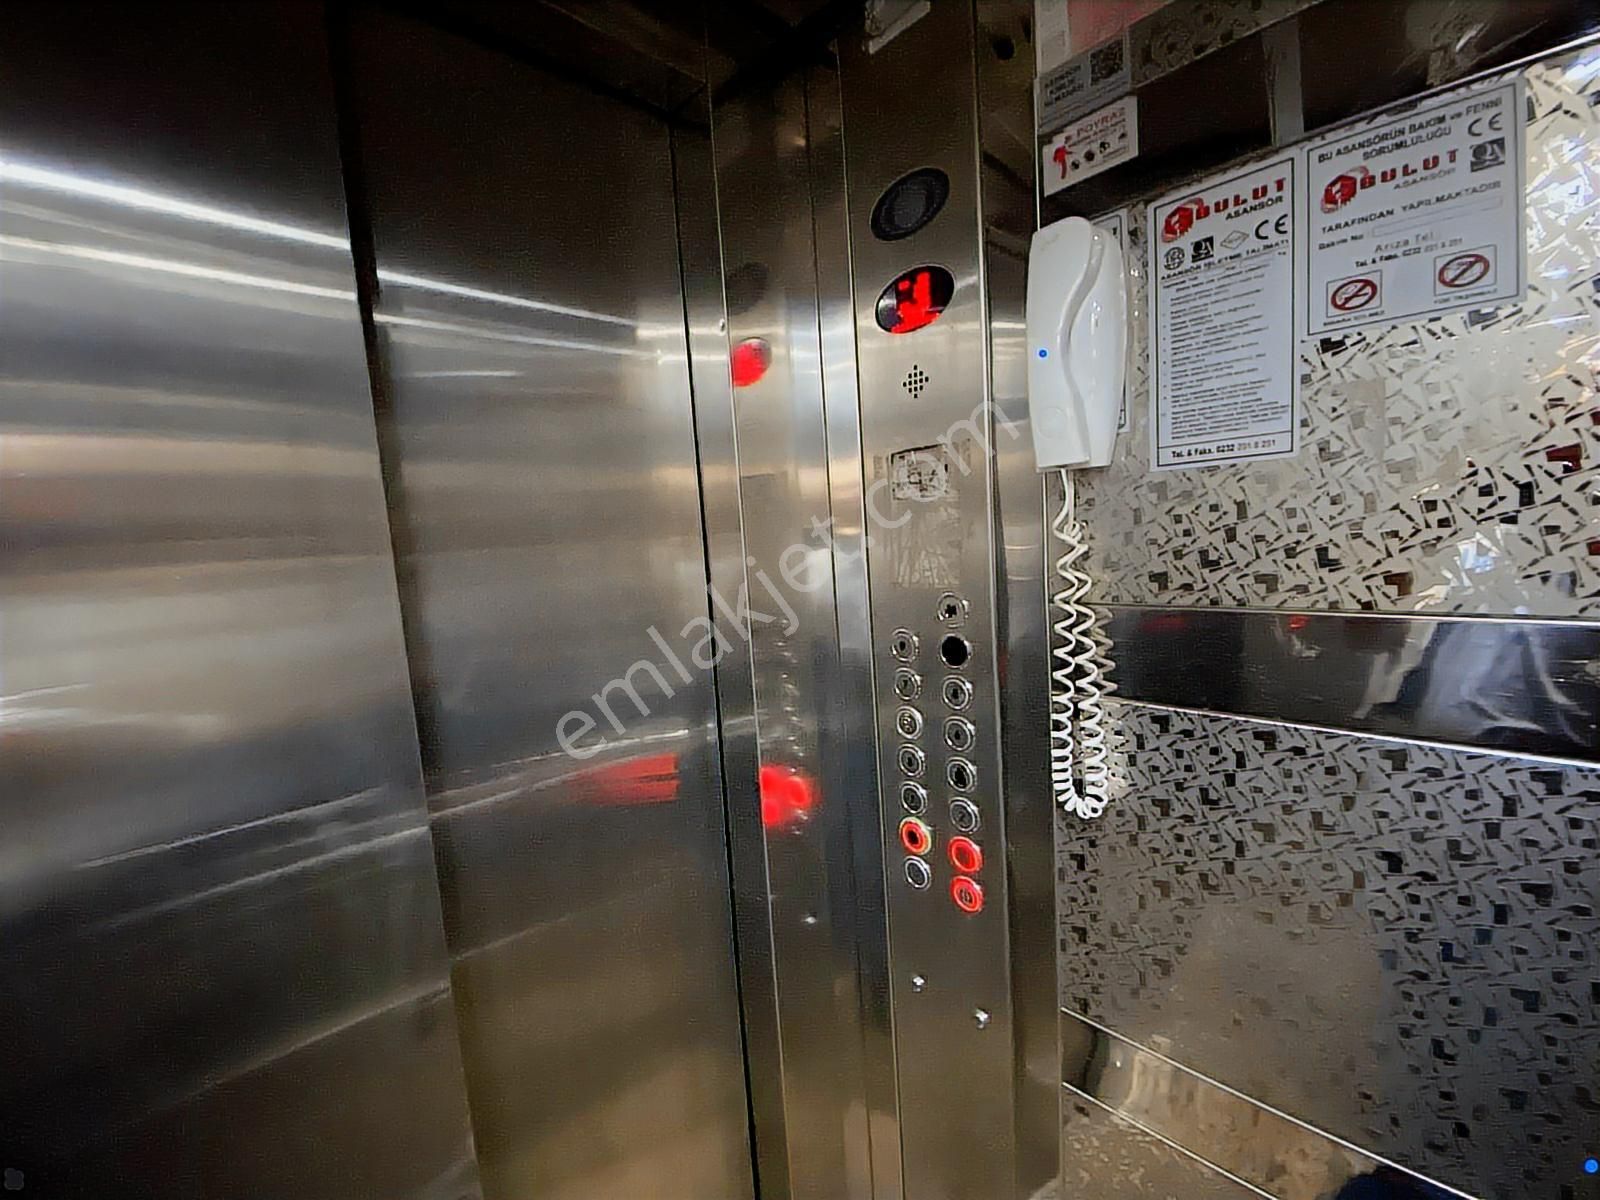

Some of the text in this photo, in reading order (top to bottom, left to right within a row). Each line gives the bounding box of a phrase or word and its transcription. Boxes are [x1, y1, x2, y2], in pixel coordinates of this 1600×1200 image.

[1409, 113, 1446, 134] BAKIM
[1360, 149, 1459, 190] BULUT
[1195, 177, 1287, 221] BULUT
[1321, 208, 1395, 235] TARAFINDAN
